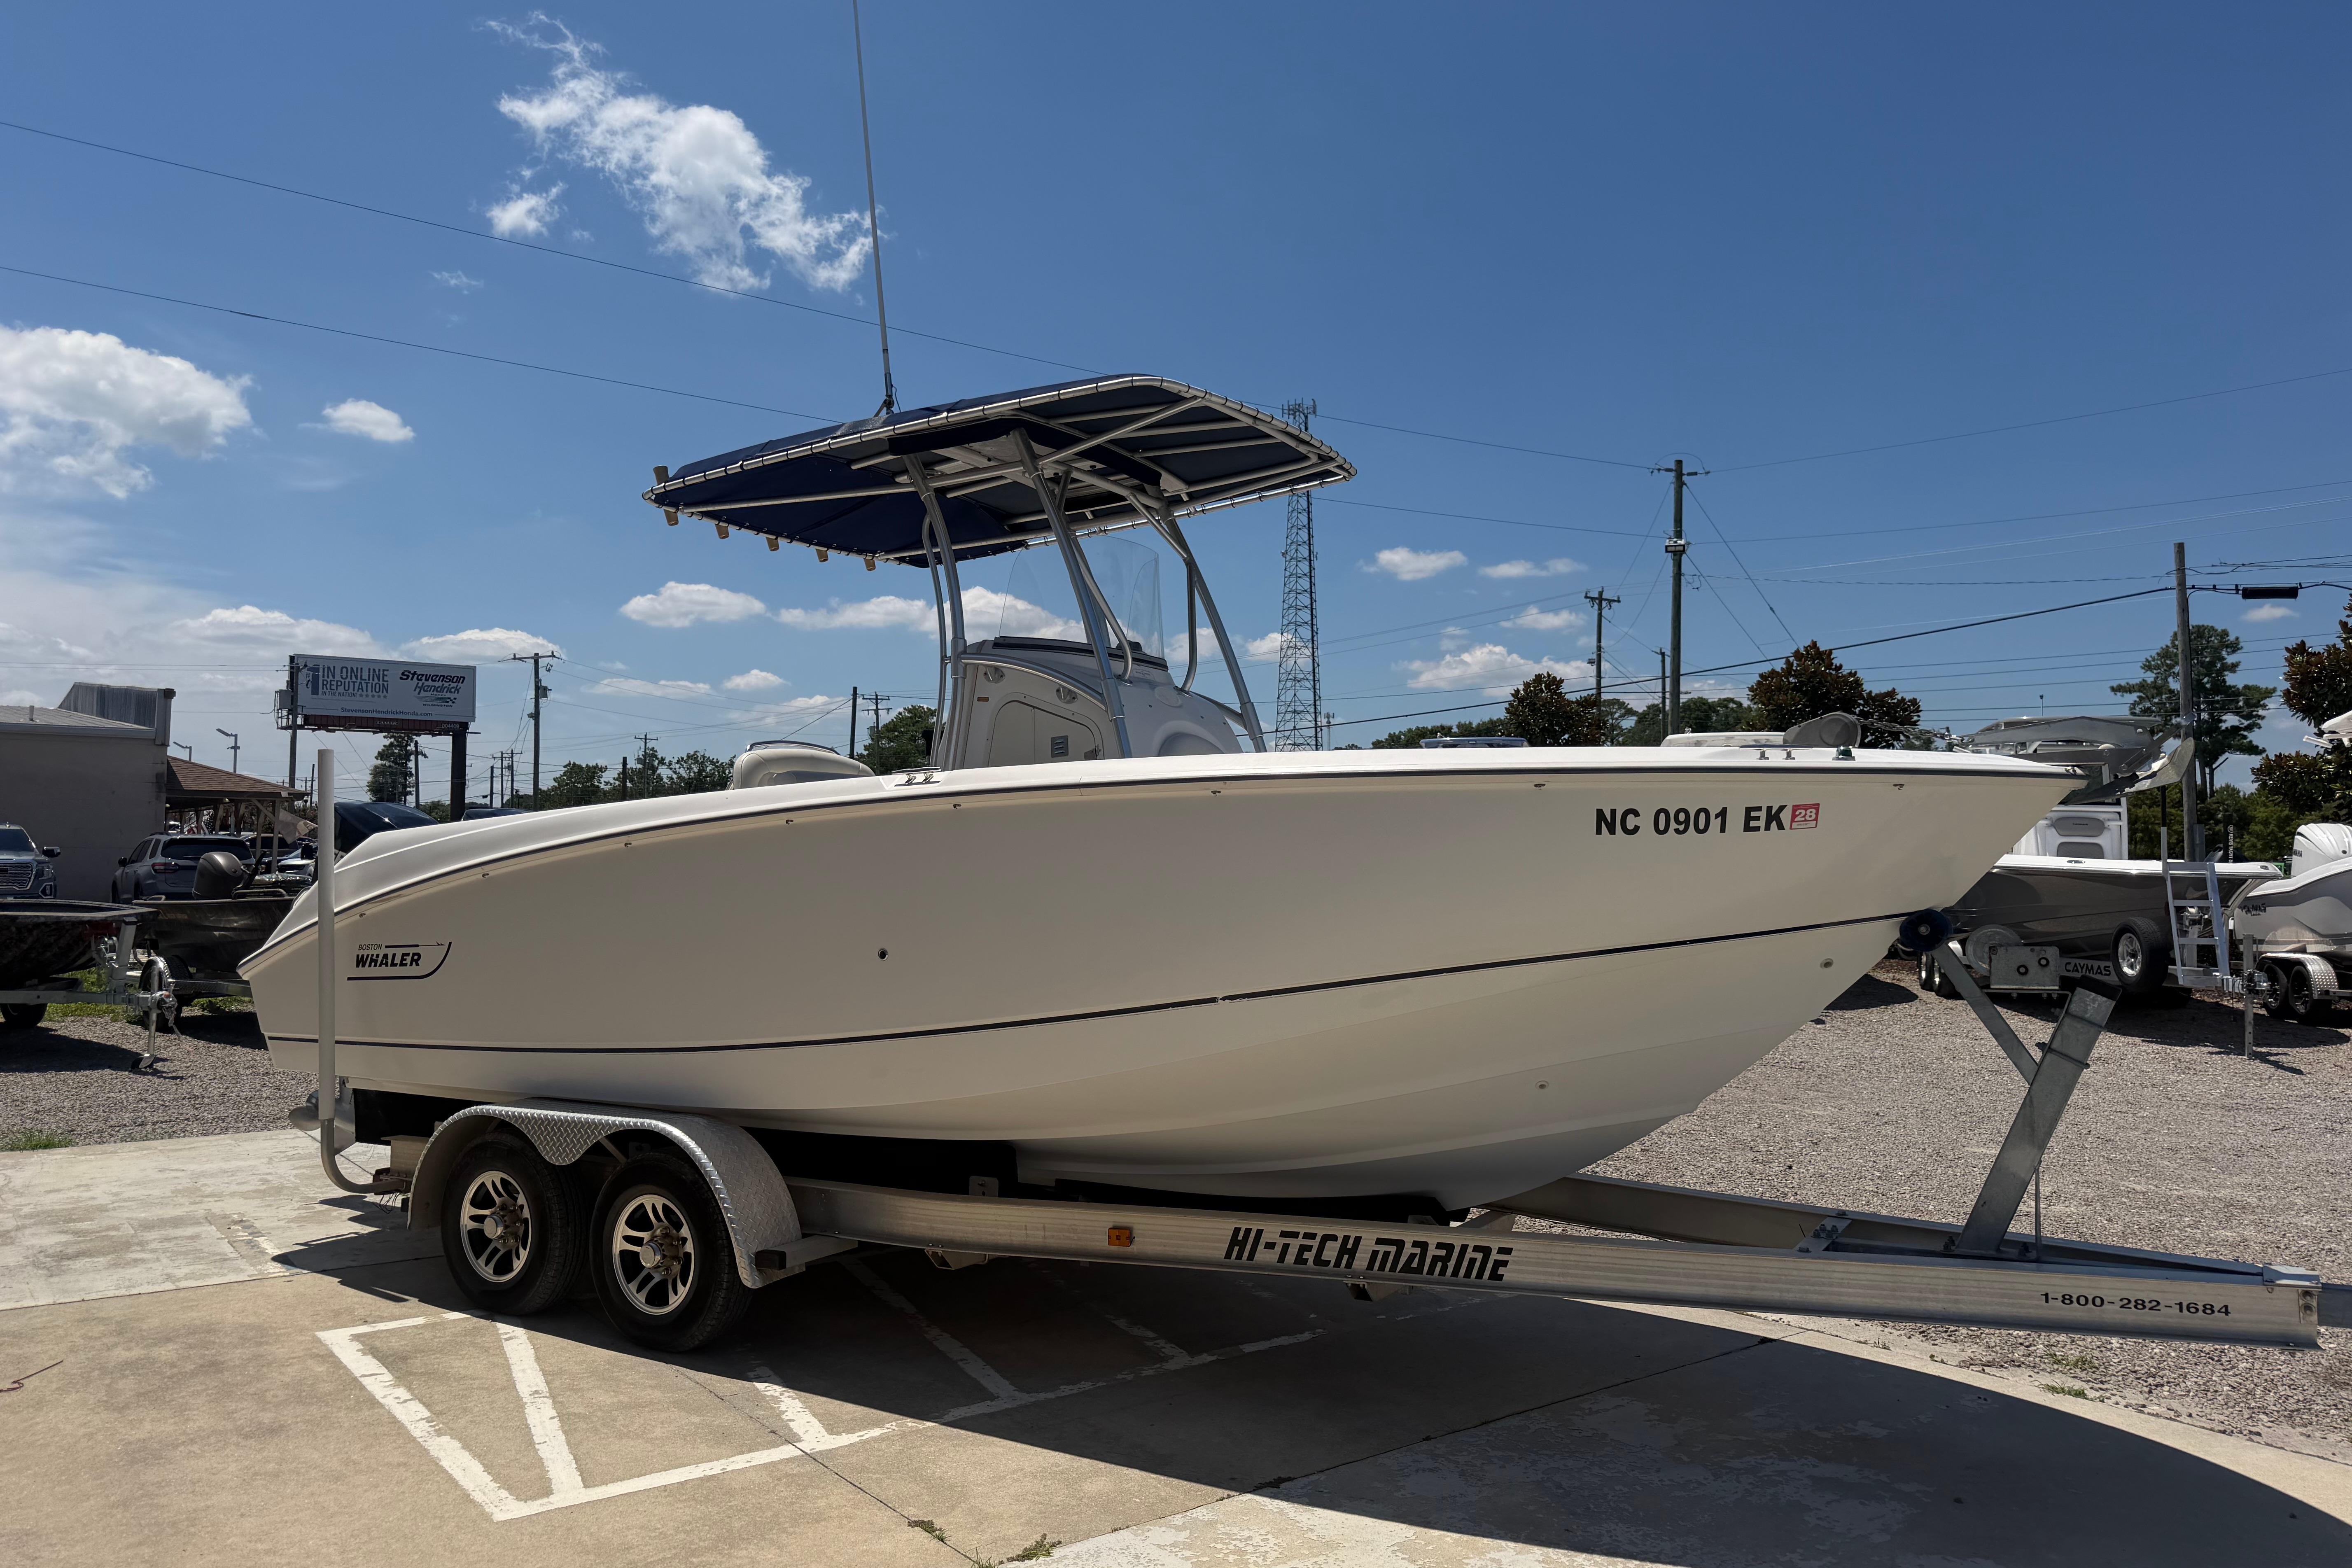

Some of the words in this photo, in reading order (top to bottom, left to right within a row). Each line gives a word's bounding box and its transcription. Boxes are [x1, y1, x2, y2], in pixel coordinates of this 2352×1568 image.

[322, 665, 336, 679] IN
[340, 666, 389, 683] ONLINE
[399, 670, 466, 684] Stevenson
[322, 679, 389, 694] REPUTATION
[413, 682, 461, 695] Hendrick
[341, 707, 432, 716] StevensonHendrickHonda.com
[1595, 807, 1640, 835] NC
[1653, 806, 1727, 835] 0901
[1743, 805, 1788, 832] EK
[1794, 808, 1816, 821] 28
[355, 952, 422, 968] WHALER
[2065, 962, 2111, 976] CAYMAS
[1223, 1226, 1362, 1269] HI-TECH
[1365, 1237, 1514, 1281] MARINE
[2040, 1292, 2231, 1316] 1-800-282-1684
